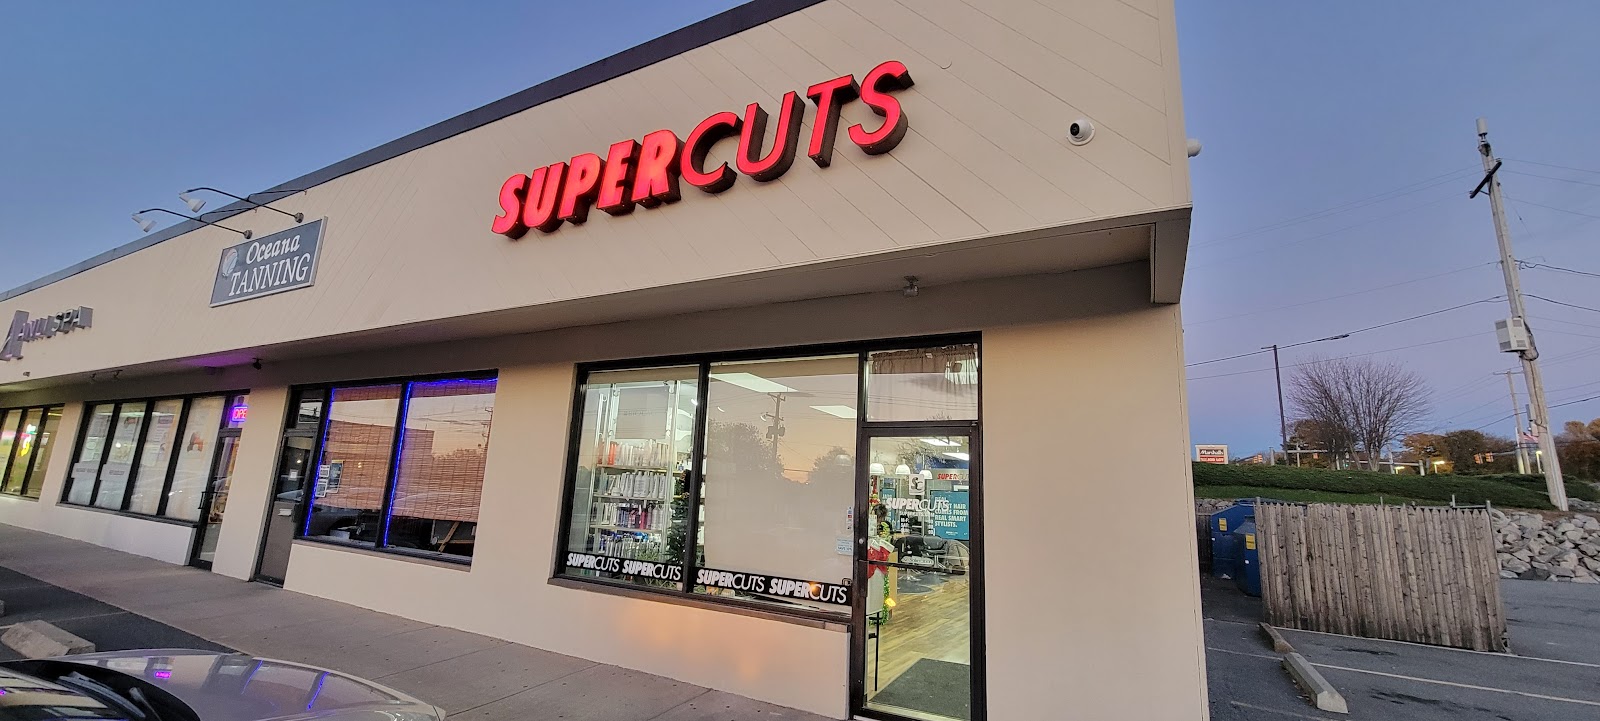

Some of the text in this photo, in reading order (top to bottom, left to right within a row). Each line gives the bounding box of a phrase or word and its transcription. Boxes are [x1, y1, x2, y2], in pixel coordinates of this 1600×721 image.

[491, 60, 914, 239] SUPERCUTS
[246, 235, 300, 264] Oceana
[228, 253, 311, 296] TANNING
[234, 408, 247, 419] OPE
[885, 498, 949, 511] SUPERCUTS
[935, 520, 958, 528] STYLISTS.
[567, 553, 682, 581] SUPERCUTS SUPERCUTS
[697, 569, 847, 604] SUPERCUTS SUPERCUTS
